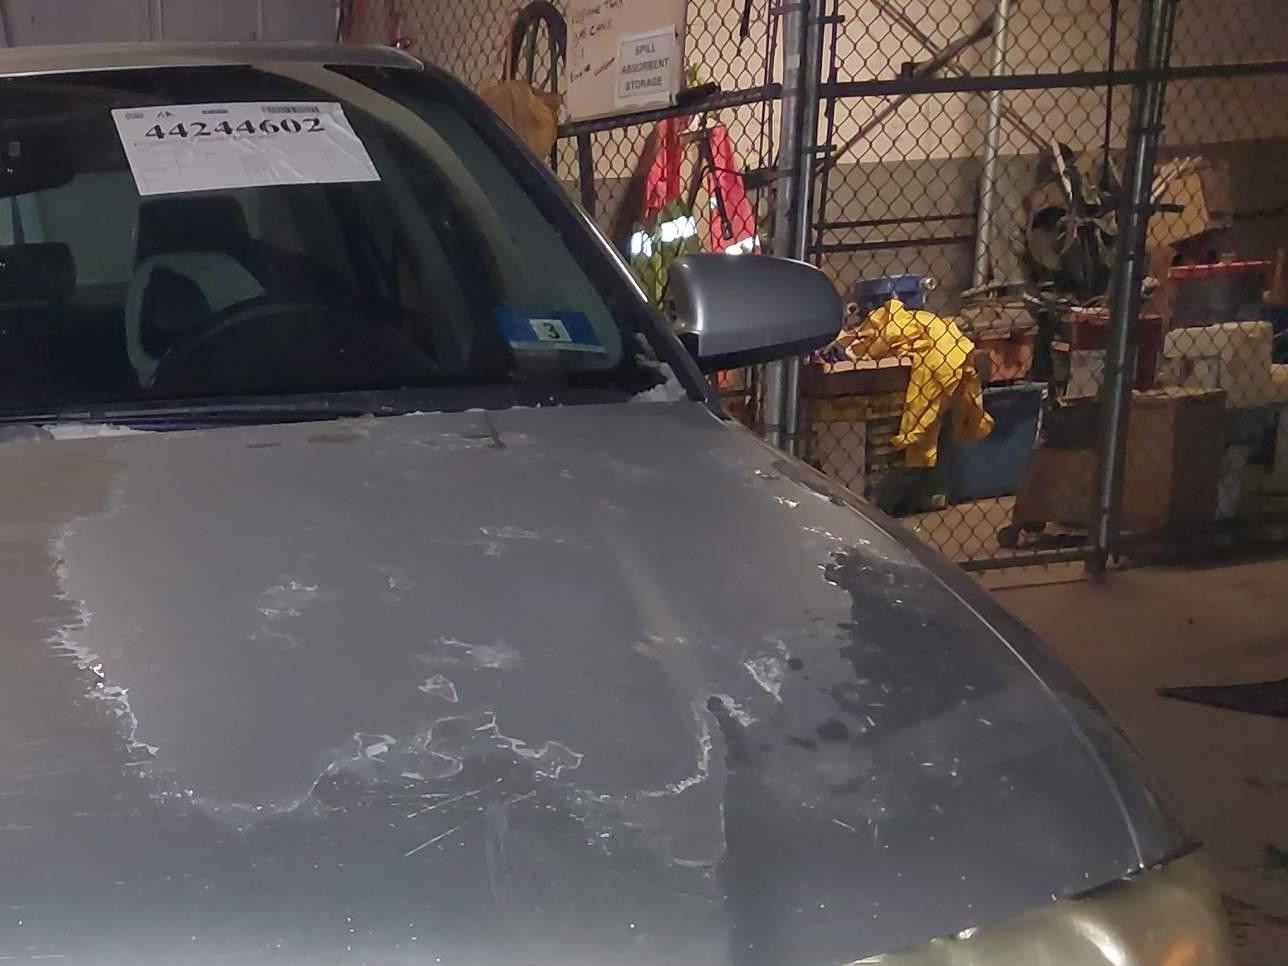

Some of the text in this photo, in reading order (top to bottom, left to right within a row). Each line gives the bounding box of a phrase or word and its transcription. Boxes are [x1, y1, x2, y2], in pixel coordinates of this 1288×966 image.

[634, 44, 656, 56] SPILL
[621, 57, 670, 75] ABSORBENT
[625, 76, 663, 91] STORAGE
[145, 118, 325, 140] 44244602
[543, 322, 561, 339] 3
